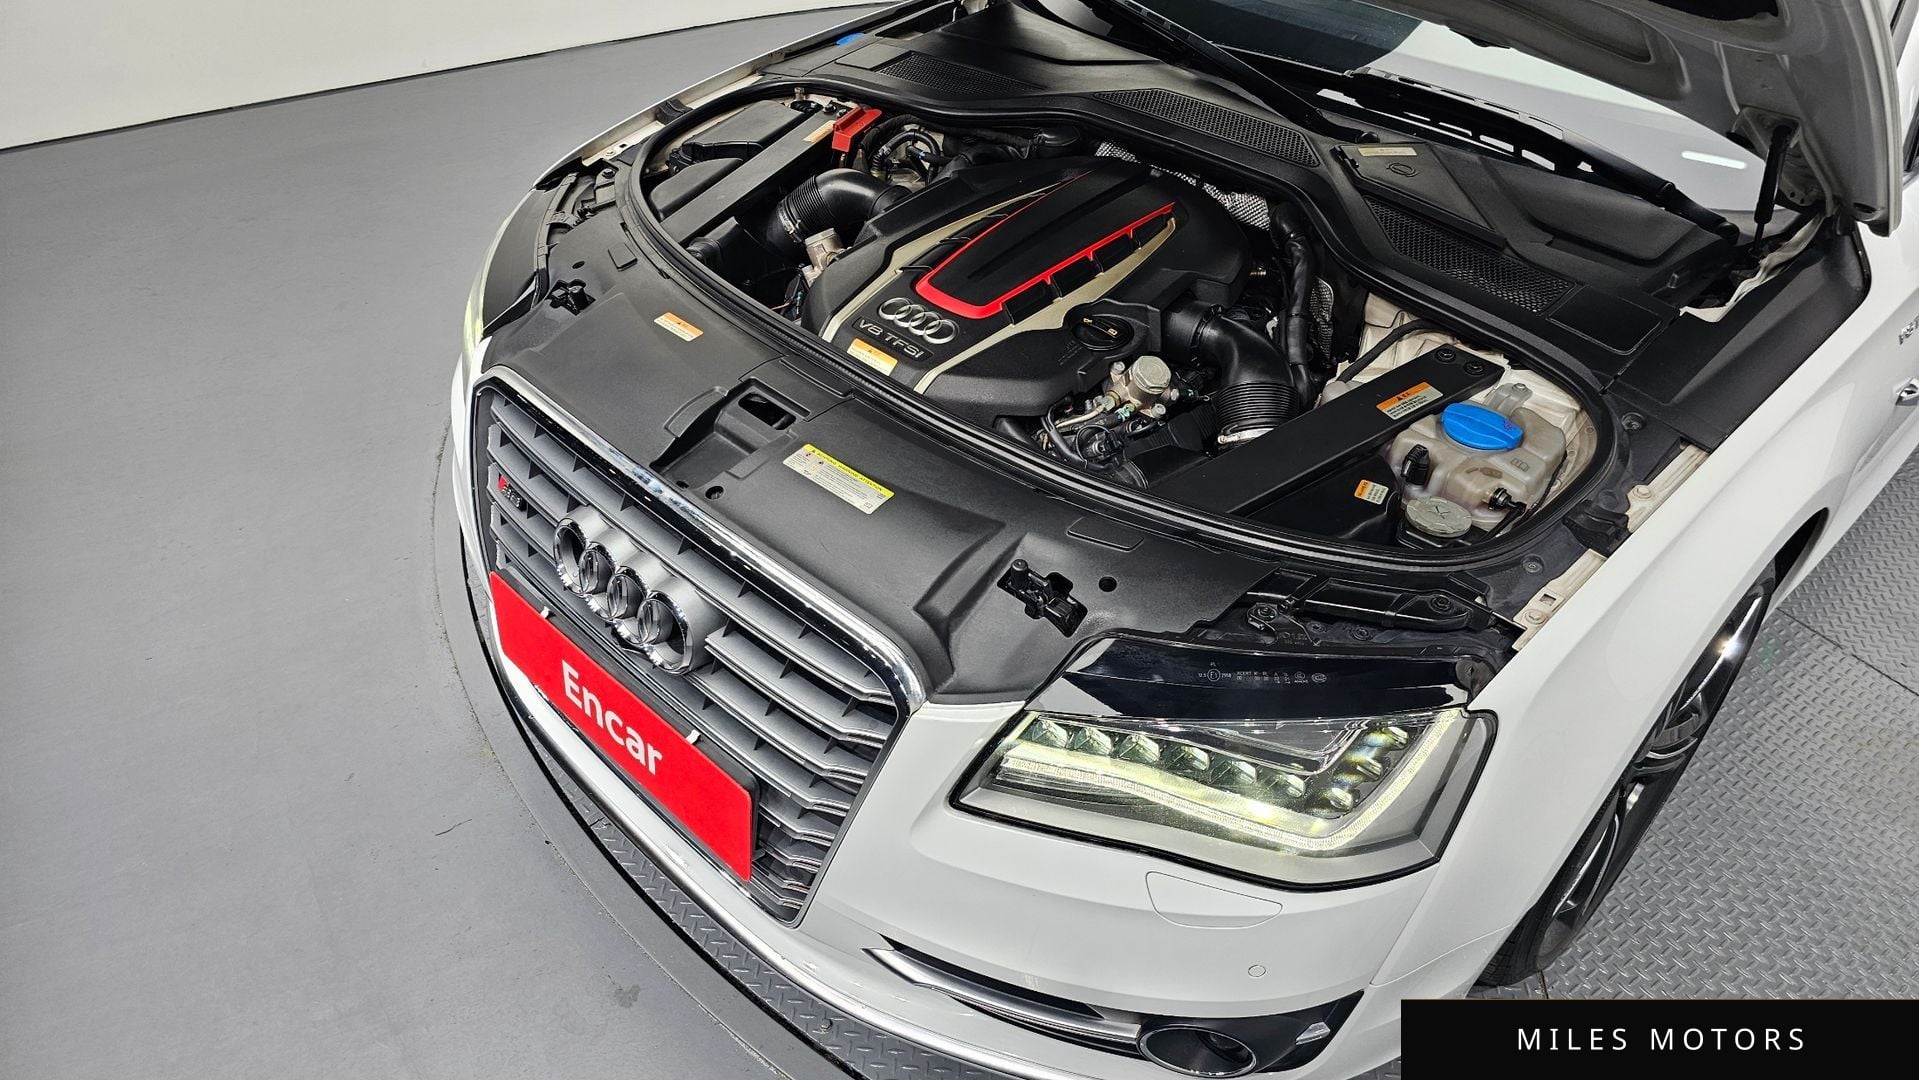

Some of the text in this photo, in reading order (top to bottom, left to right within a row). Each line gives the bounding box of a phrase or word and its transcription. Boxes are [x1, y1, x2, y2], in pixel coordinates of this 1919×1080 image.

[859, 319, 883, 336] V8
[885, 332, 924, 358] TFSI
[859, 475, 882, 492] ATTENTION
[562, 659, 663, 776] Encar
